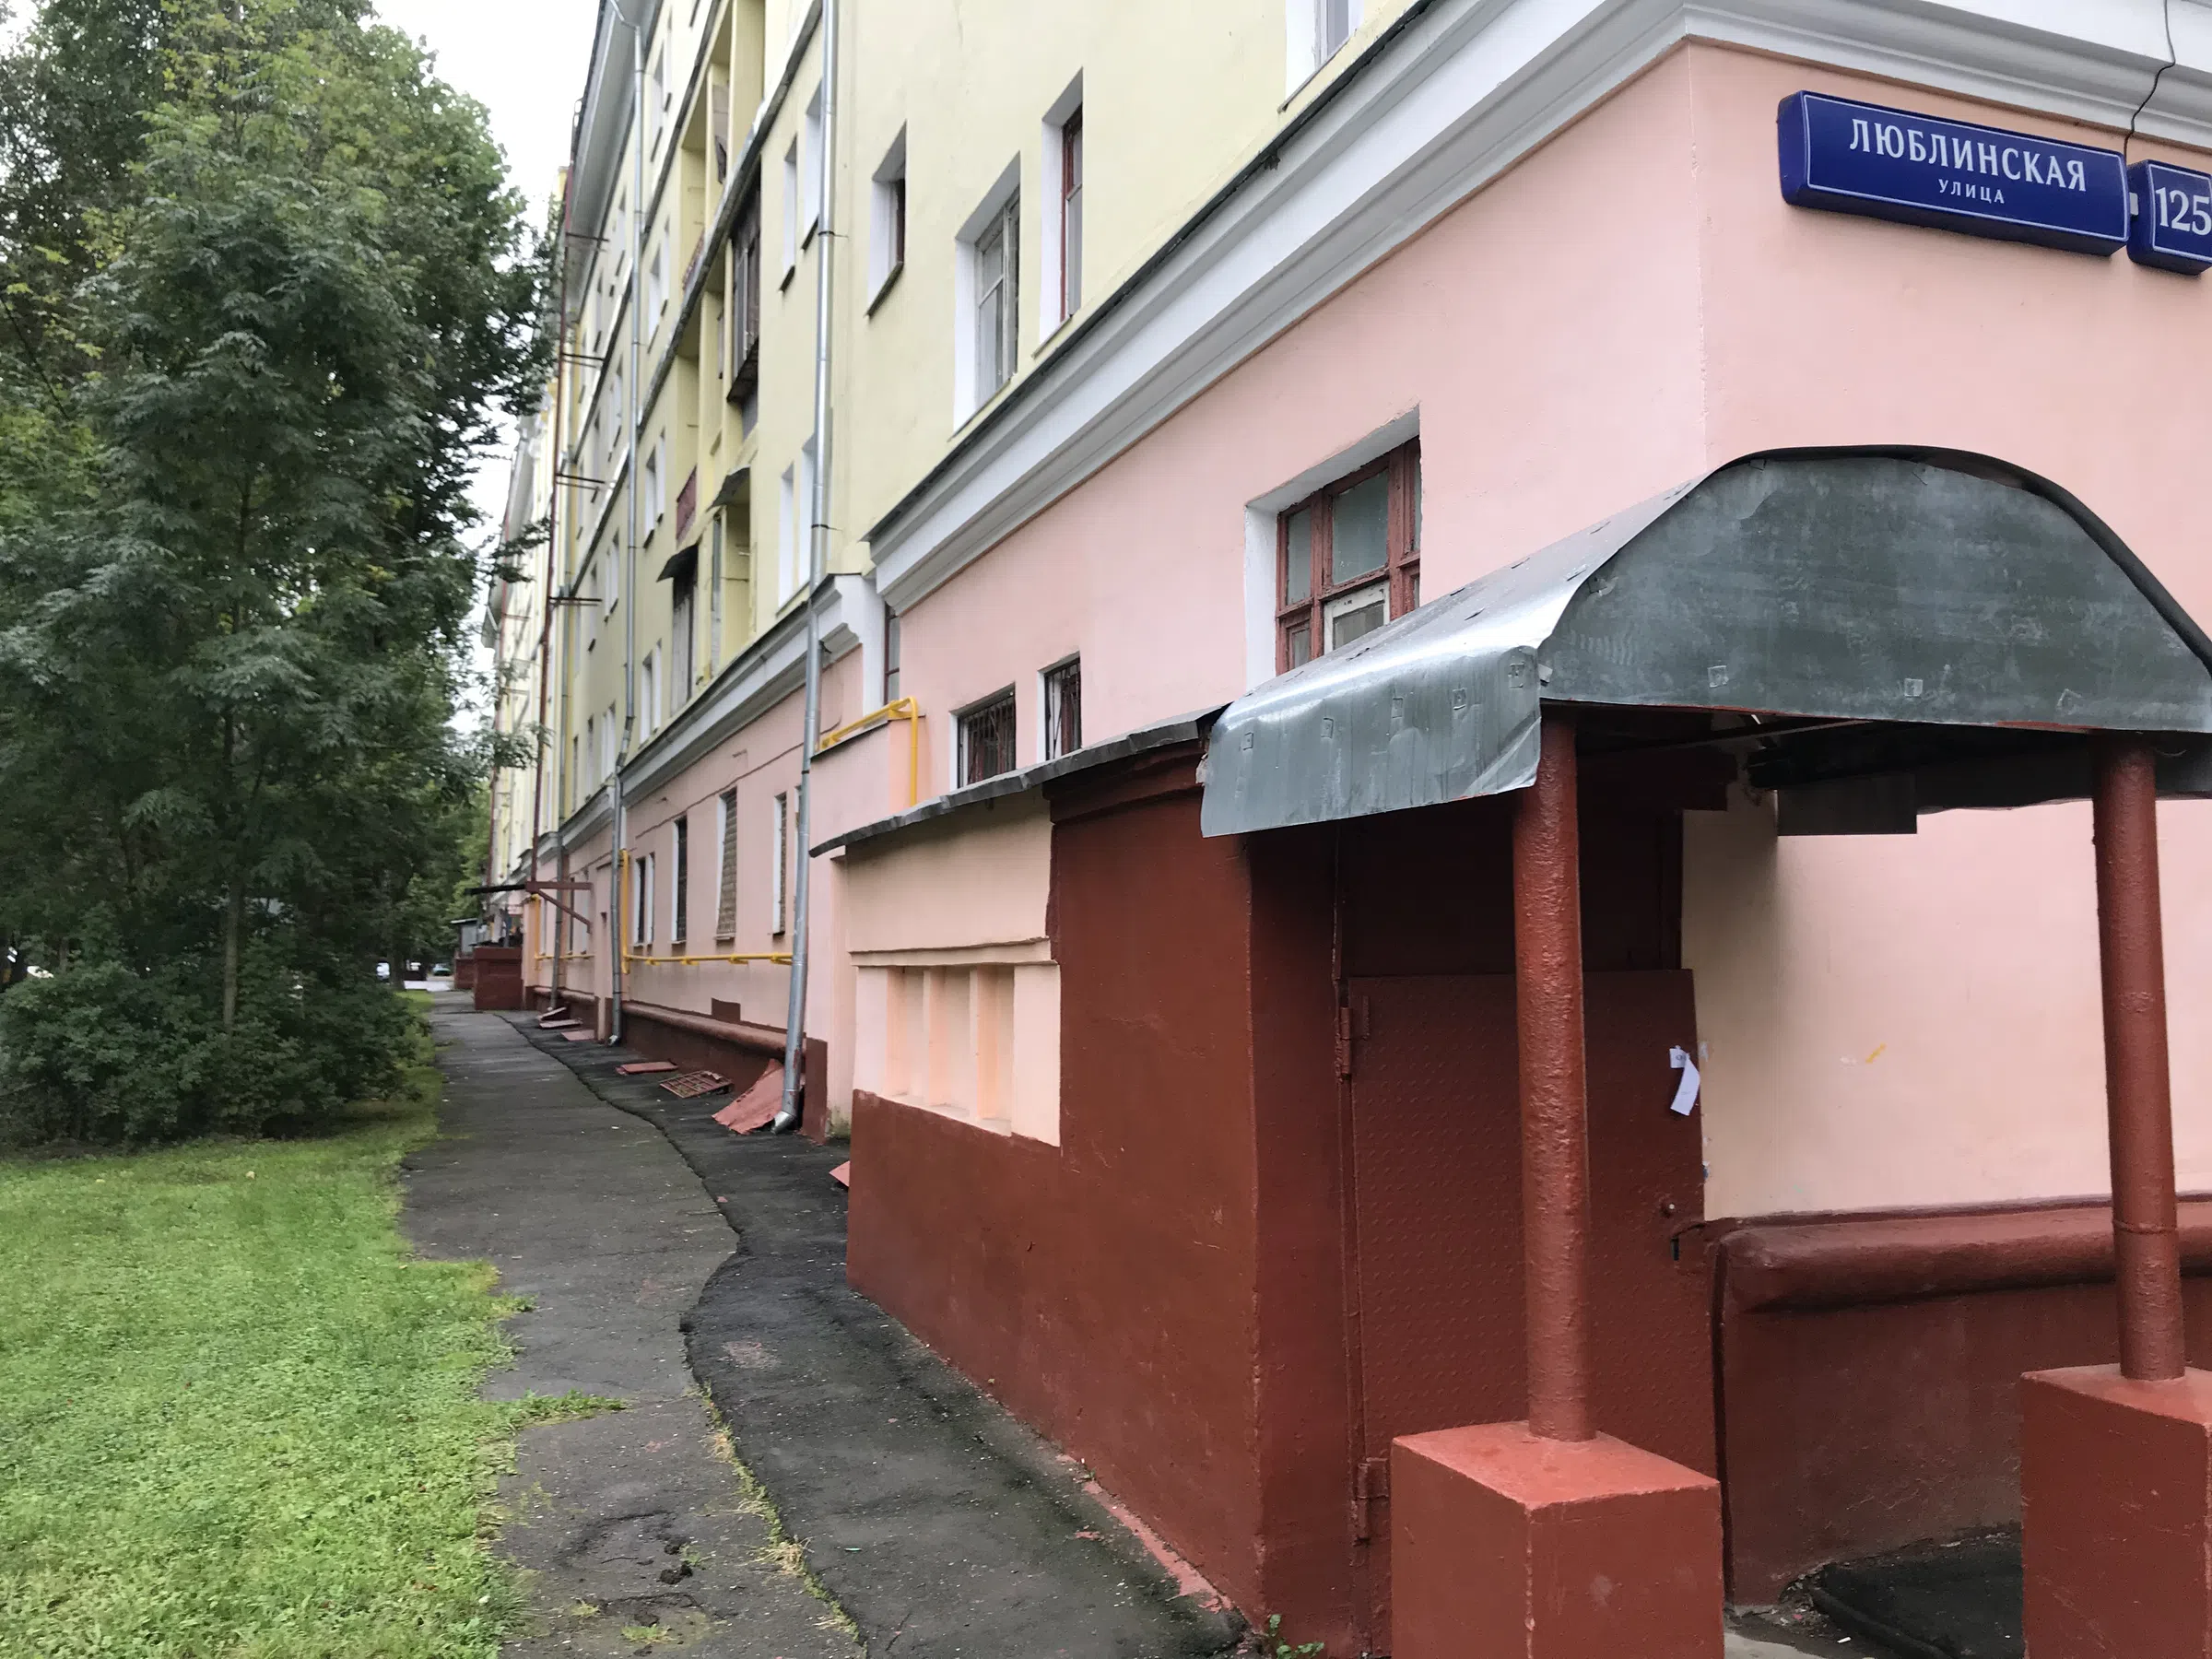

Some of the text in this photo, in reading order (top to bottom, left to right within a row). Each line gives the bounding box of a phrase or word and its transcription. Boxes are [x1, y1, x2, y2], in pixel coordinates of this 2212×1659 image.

[1849, 118, 2087, 192] ЛЮБЛИНСКАЯ
[1938, 179, 2005, 204] УЛИЦА
[2155, 186, 2212, 236] 125
